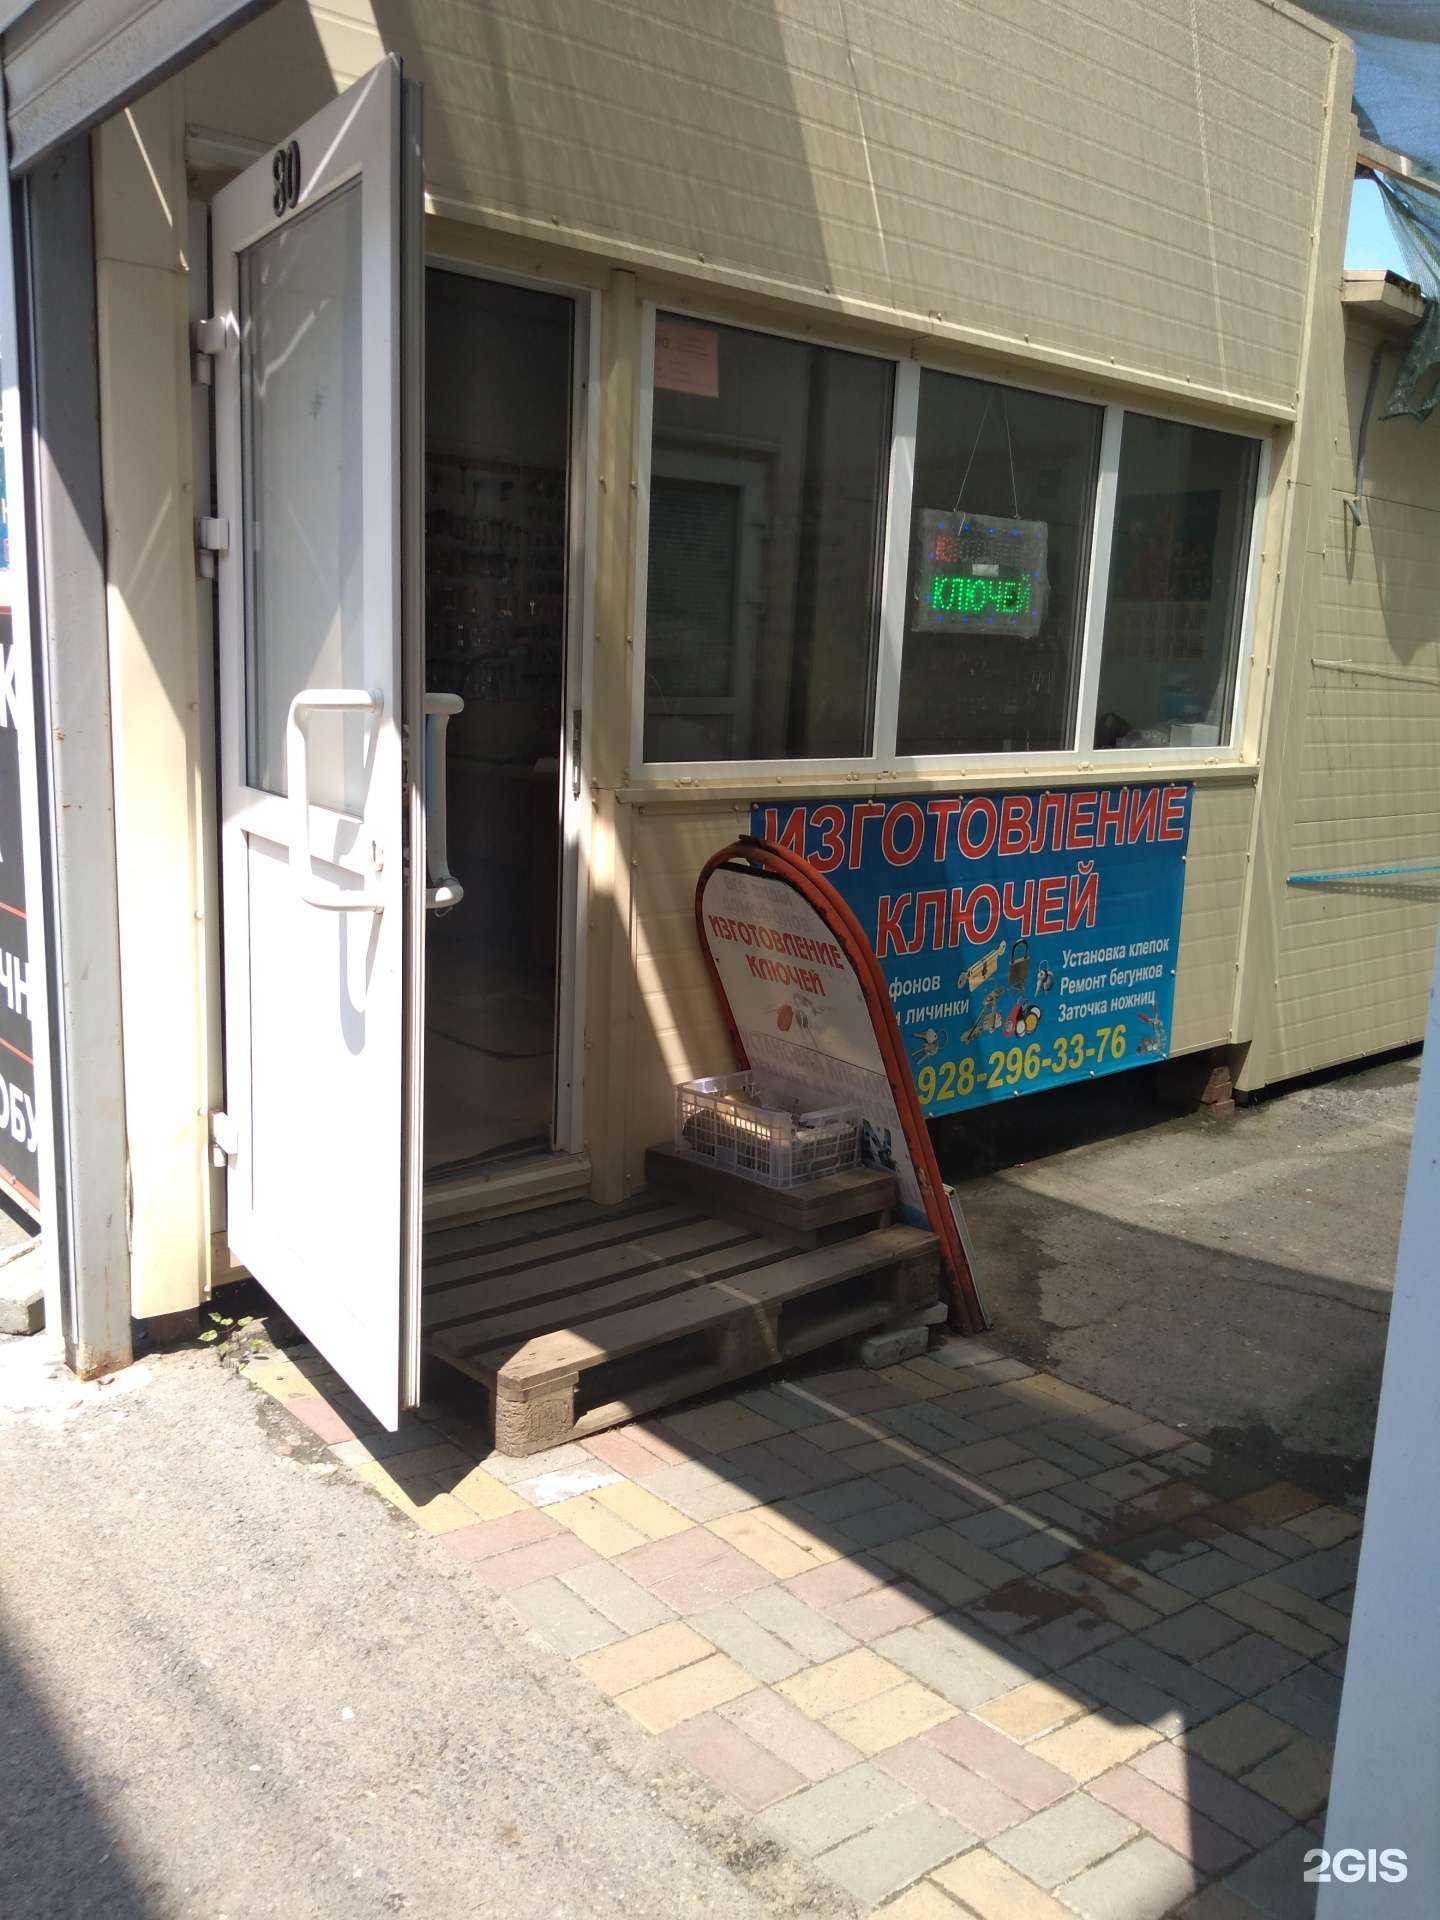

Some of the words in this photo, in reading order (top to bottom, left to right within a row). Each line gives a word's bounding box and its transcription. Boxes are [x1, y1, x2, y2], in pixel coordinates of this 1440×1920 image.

[762, 786, 1188, 874] ИЗГОТОВЛЕНИЕ
[875, 859, 1099, 959] КЛЮЧЕЙ
[708, 914, 845, 970] ИЗГОТОВЛЕНИЕ
[1062, 944, 1126, 969] Установка
[1129, 938, 1170, 957] клепок
[745, 953, 826, 997] КЛЮЧЕЙ
[1060, 973, 1107, 996] Ремонт
[1110, 964, 1163, 988] бегунков
[905, 999, 970, 1025] личинки
[1058, 1000, 1108, 1022] Заточка
[1111, 990, 1156, 1012] ножниц
